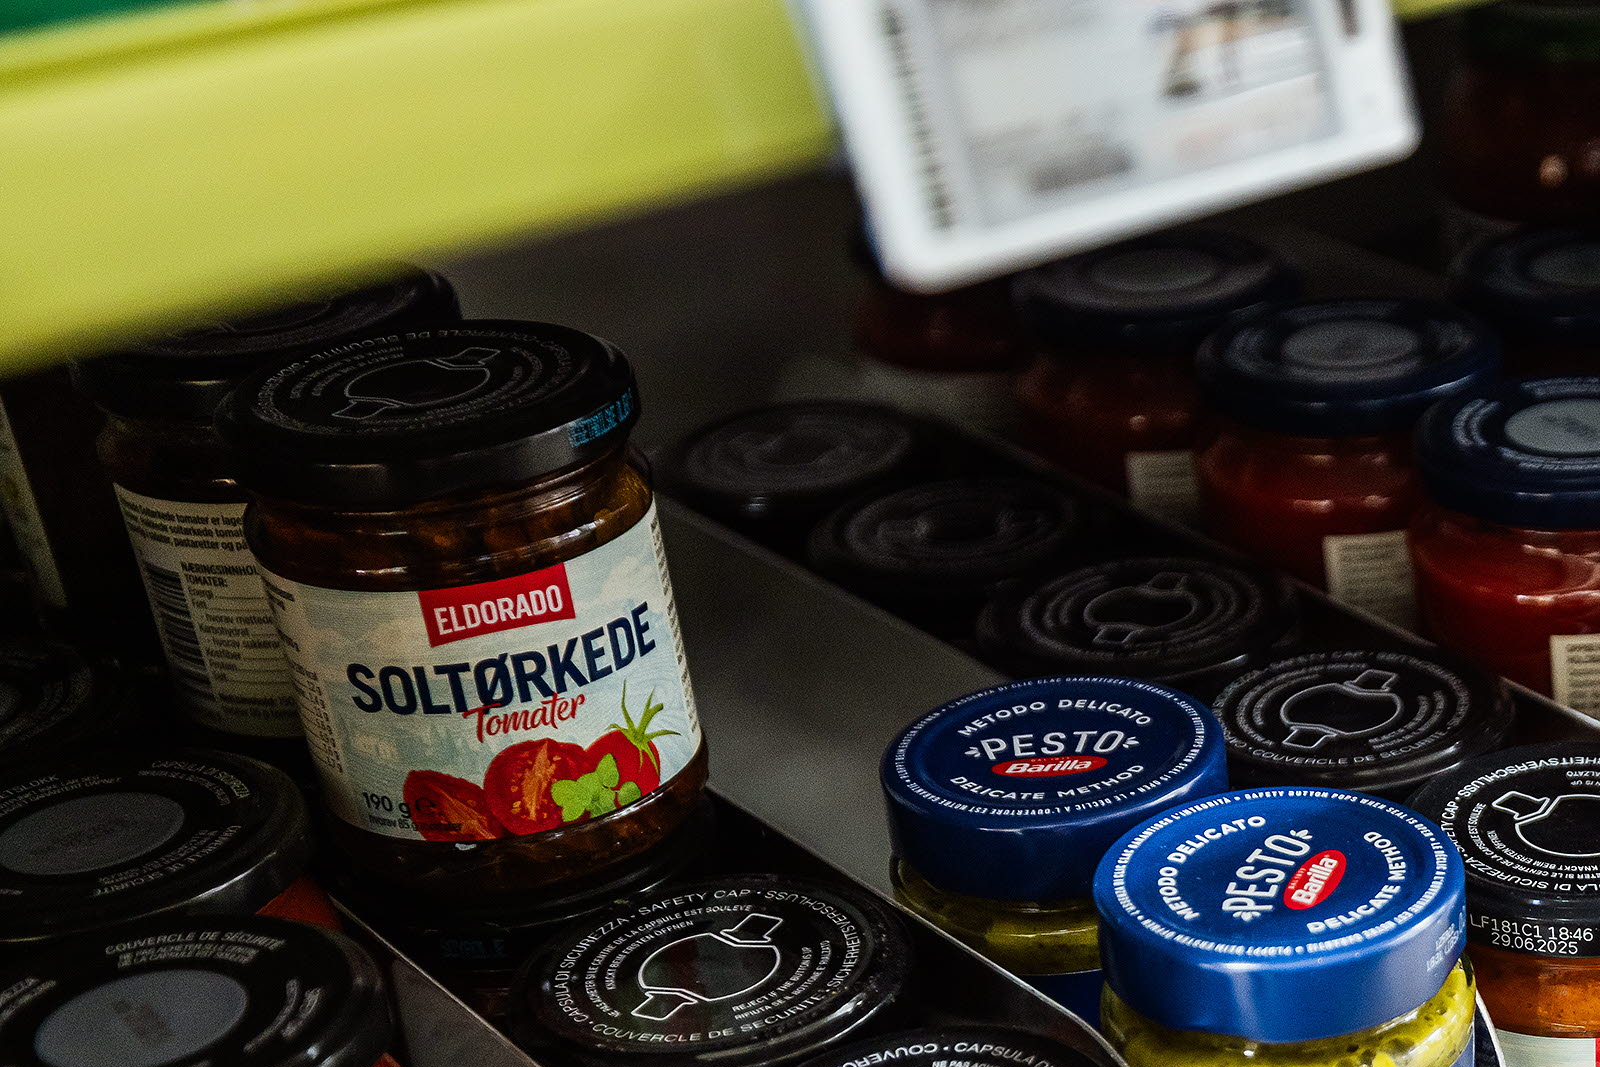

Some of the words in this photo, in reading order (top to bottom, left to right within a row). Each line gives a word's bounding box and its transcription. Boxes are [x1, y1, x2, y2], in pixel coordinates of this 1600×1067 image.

[181, 562, 258, 576] NÆRINGSINNHOL
[433, 584, 564, 636] ELDORADO
[347, 602, 655, 715] SOLTØRKEDE
[464, 691, 585, 744] Tomater
[957, 700, 1047, 738] METODO
[1057, 698, 1153, 727] DELICATO
[980, 729, 1126, 761] PESTO
[1251, 749, 1348, 766] COUVERCLE
[1353, 756, 1375, 764] DE
[949, 775, 1045, 801] DELICATE
[1056, 764, 1145, 799] METHOD
[1004, 758, 1093, 775] Barilla
[362, 790, 395, 813] 190
[399, 800, 413, 818] g
[1244, 790, 1285, 800] SAFETY
[1287, 790, 1329, 798] BUTTON
[1331, 792, 1358, 802] POPS
[1360, 797, 1388, 811] WHEN
[1386, 805, 1408, 820] SEAL
[1406, 813, 1418, 825] IS
[1441, 799, 1459, 820] CAP
[1166, 815, 1267, 865] DELICATO
[1221, 833, 1311, 912] PESTO
[1290, 854, 1339, 906] Barilla
[1306, 884, 1402, 934] DELICATE
[1362, 830, 1407, 881] METHOD
[1464, 856, 1550, 890] SICUREZZA
[1553, 882, 1573, 892] DI
[637, 891, 708, 917] SAFETY
[713, 888, 751, 900] CAP
[1157, 866, 1200, 921] METODO
[559, 916, 630, 970] SICUREZZA
[1469, 914, 1543, 939] LF181C1
[1548, 926, 1594, 942] 18:46
[1491, 932, 1579, 955] 29.06.2025
[554, 970, 571, 982] DI
[554, 983, 590, 1023] CAPSULA
[592, 1022, 702, 1043] COUVERCLE
[708, 1027, 736, 1040] DE
[953, 1042, 1036, 1066] CAPSULA
